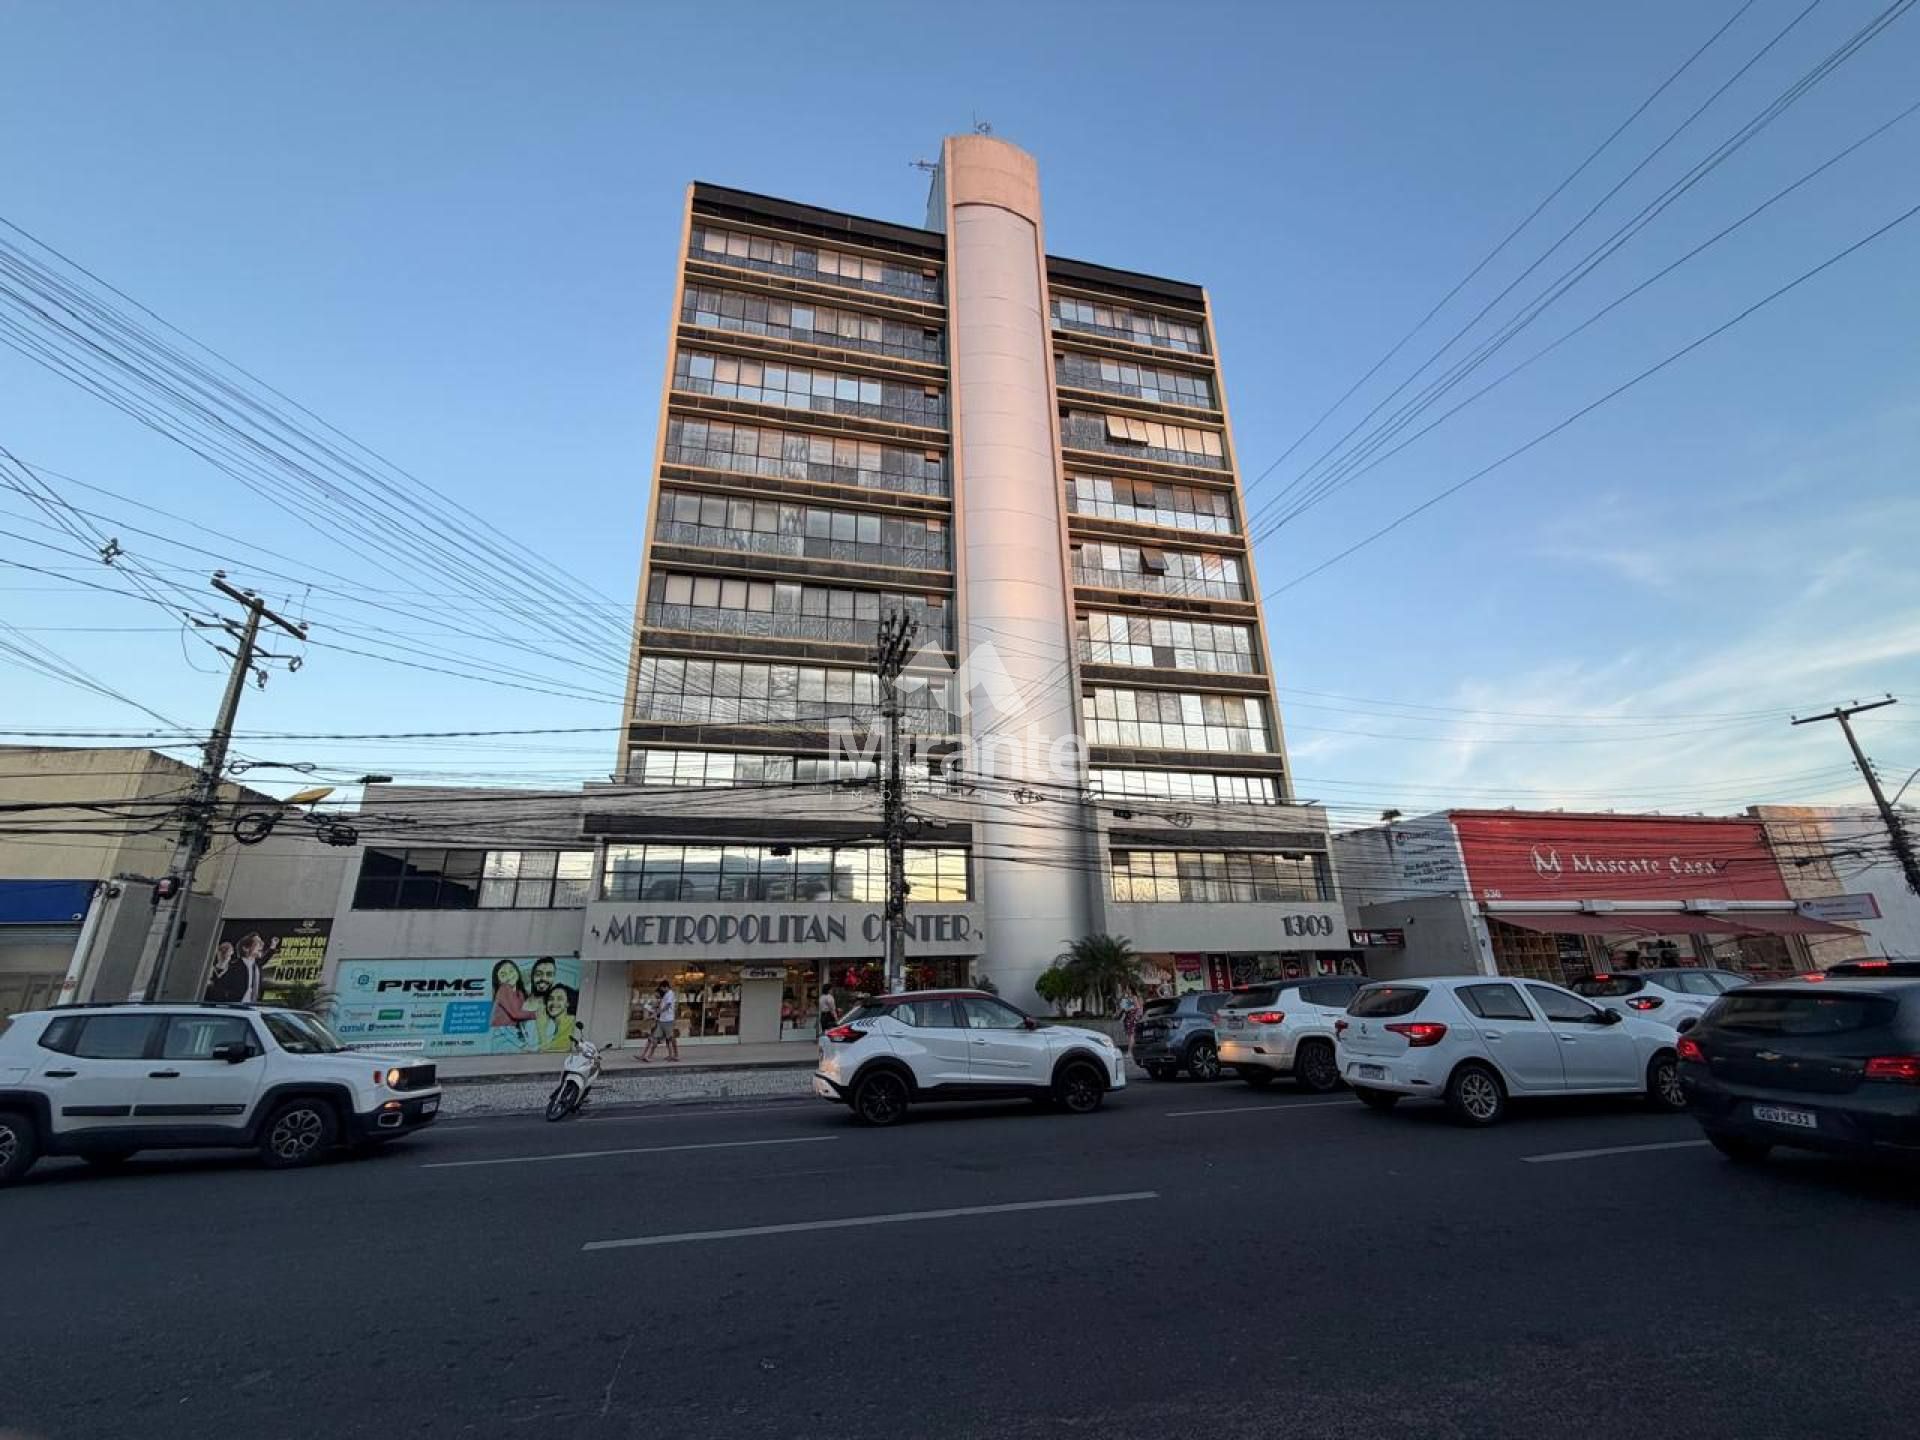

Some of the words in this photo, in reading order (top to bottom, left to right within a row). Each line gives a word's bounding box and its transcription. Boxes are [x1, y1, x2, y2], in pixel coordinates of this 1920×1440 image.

[1571, 854, 1659, 875] Mascate
[1669, 856, 1718, 875] Casa
[604, 914, 847, 945] METROPOLITAN
[1281, 914, 1333, 937] 1309
[275, 966, 318, 981] NOME!
[377, 978, 486, 992] PRIME
